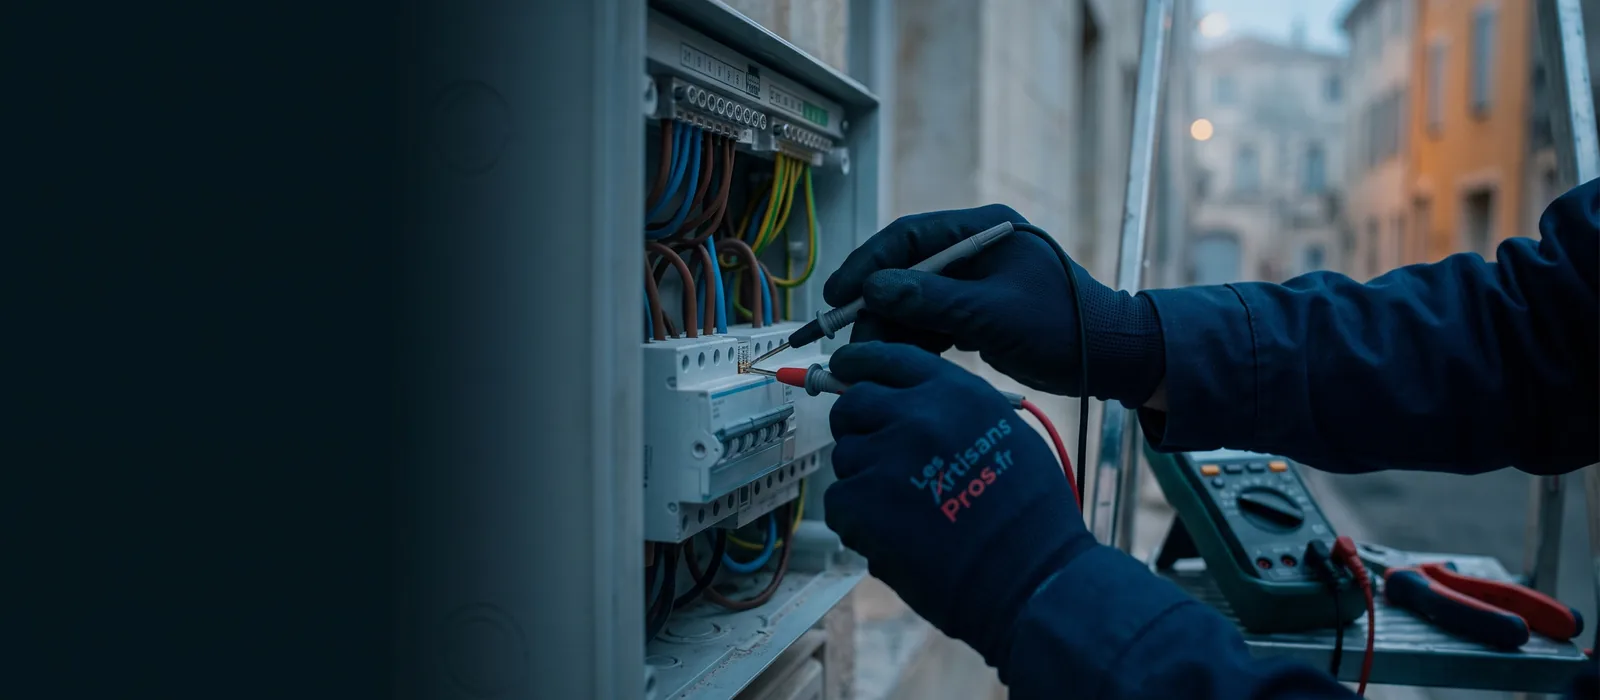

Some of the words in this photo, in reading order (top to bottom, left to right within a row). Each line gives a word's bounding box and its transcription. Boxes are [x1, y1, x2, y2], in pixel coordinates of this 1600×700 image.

[910, 456, 944, 490] Les
[930, 419, 1012, 505] Artisans
[941, 449, 1014, 522] Pros.fr
